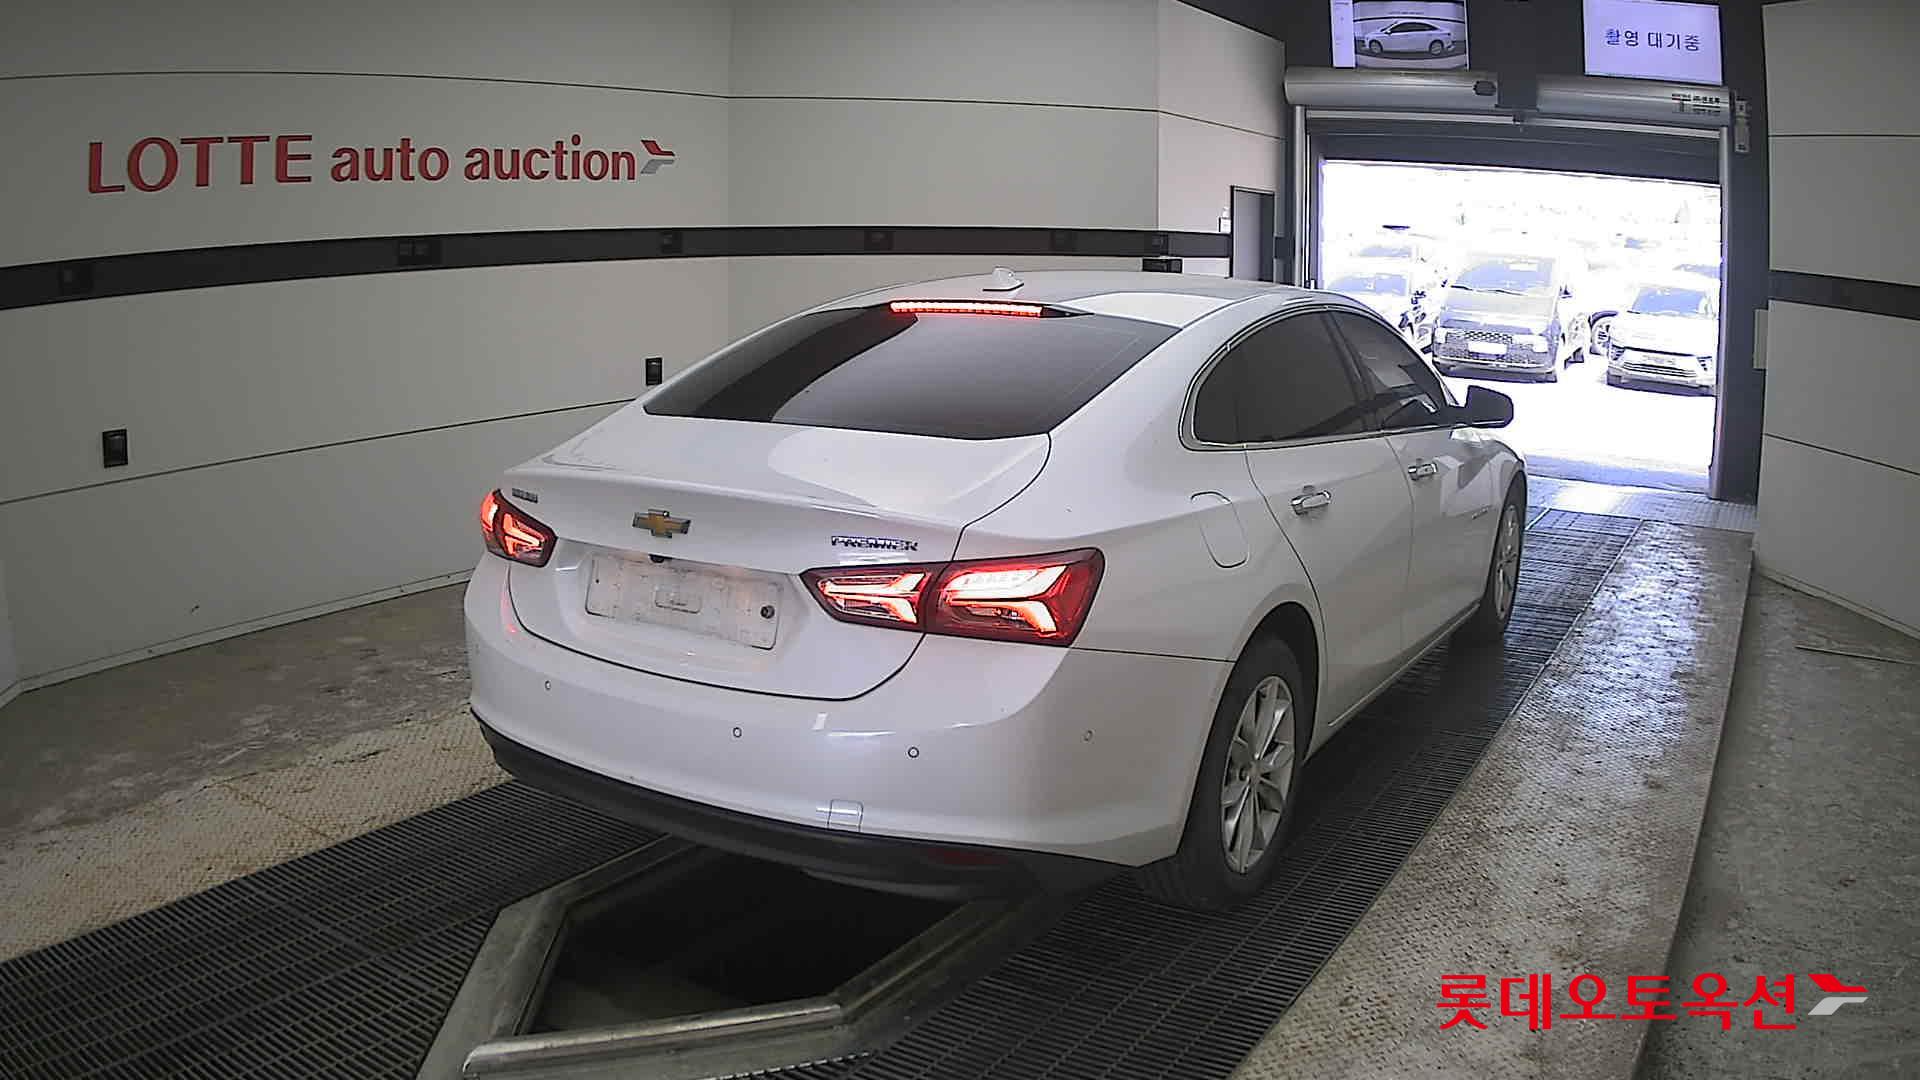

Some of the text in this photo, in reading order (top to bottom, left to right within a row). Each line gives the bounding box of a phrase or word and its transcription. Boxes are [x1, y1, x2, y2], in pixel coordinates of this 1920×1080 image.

[1647, 31, 1701, 52] 대기중
[88, 134, 637, 194] LOTTE auto auction
